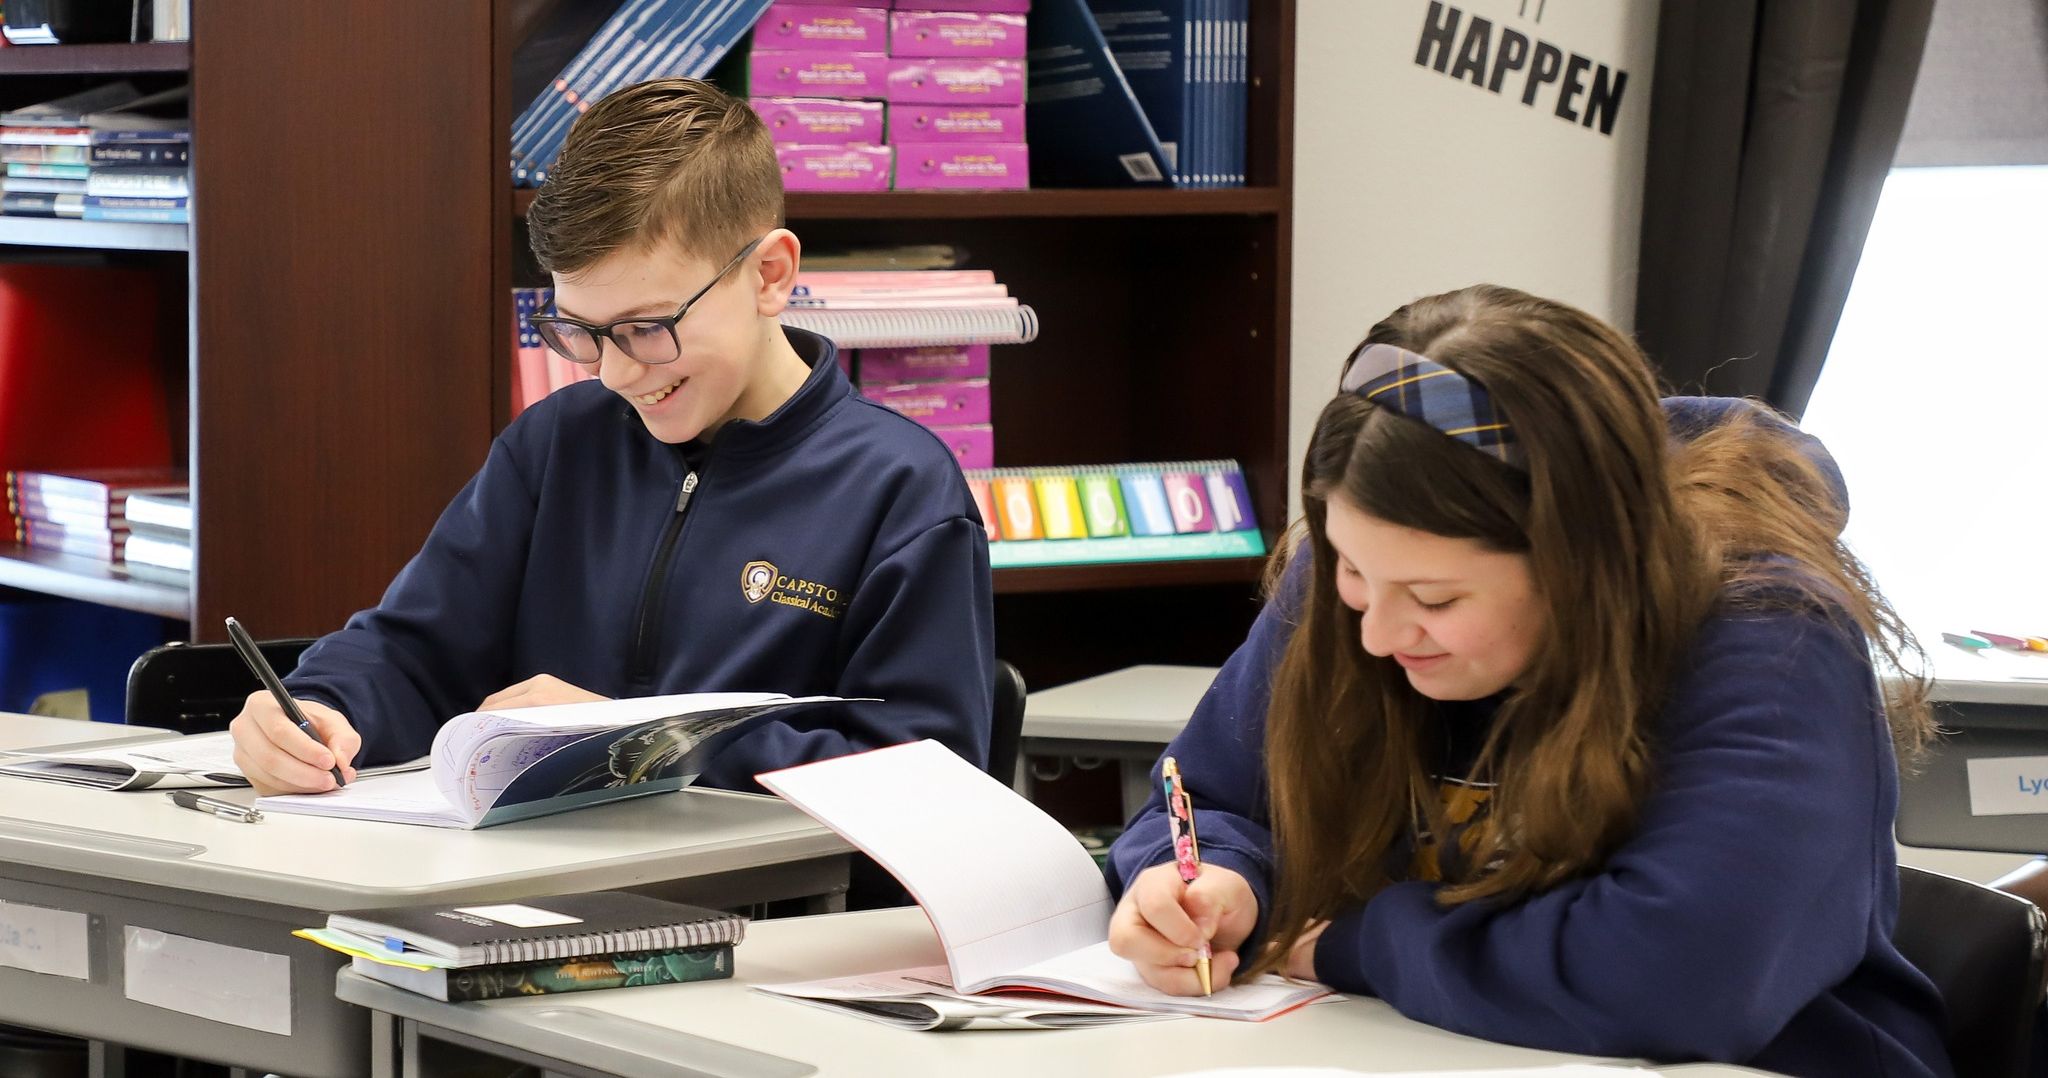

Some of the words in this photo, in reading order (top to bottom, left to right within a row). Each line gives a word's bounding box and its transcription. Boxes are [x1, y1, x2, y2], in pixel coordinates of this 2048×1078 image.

[1414, 0, 1629, 136] HAPPEN
[771, 591, 811, 609] Classical
[777, 575, 841, 602] CAPSTO
